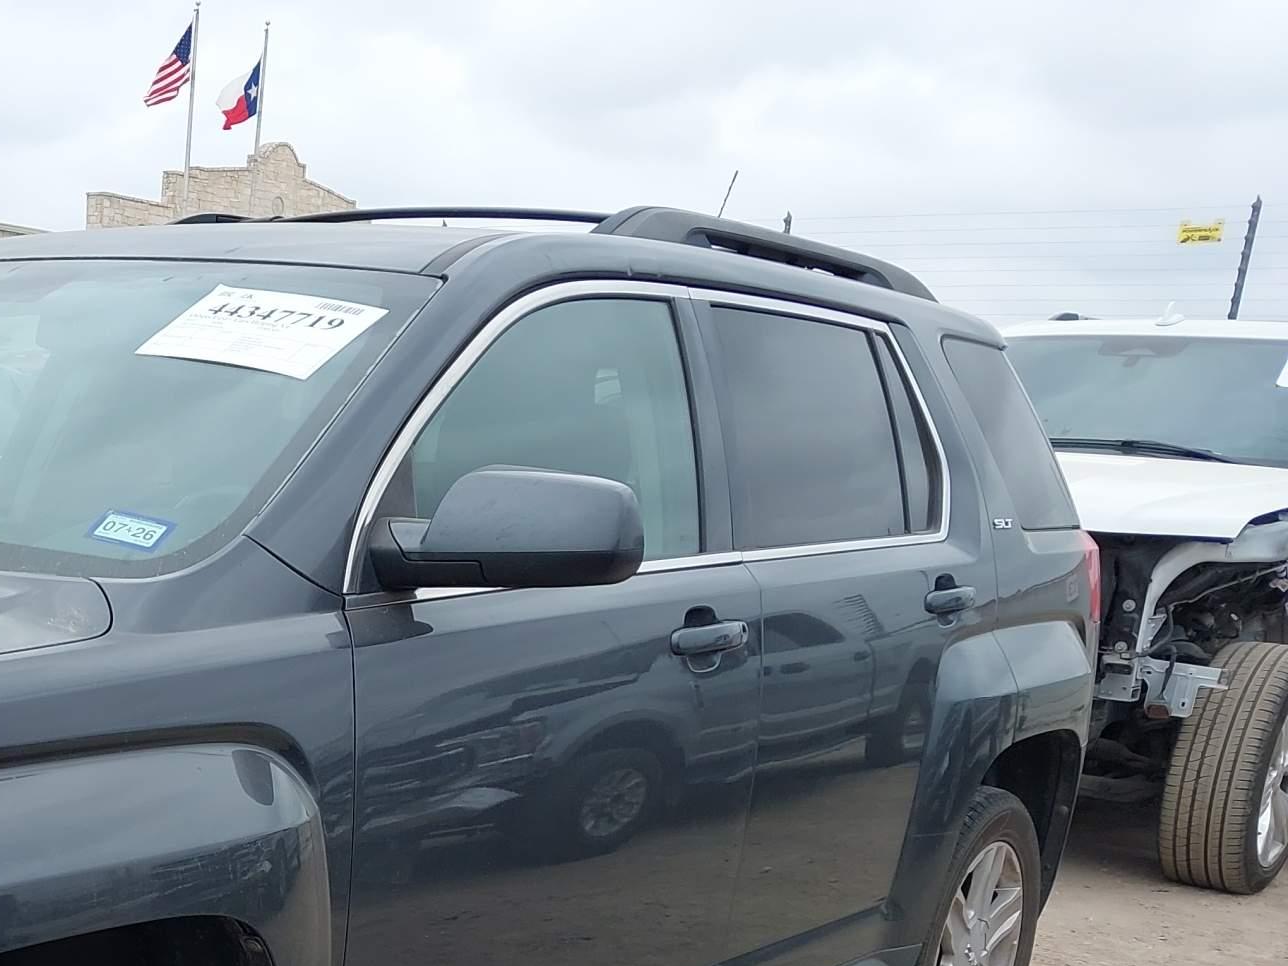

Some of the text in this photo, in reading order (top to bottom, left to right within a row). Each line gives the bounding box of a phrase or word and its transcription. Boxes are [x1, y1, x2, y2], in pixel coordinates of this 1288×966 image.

[207, 301, 345, 331] 44347719
[102, 520, 157, 541] 07 26
[993, 518, 1013, 529] SLT
